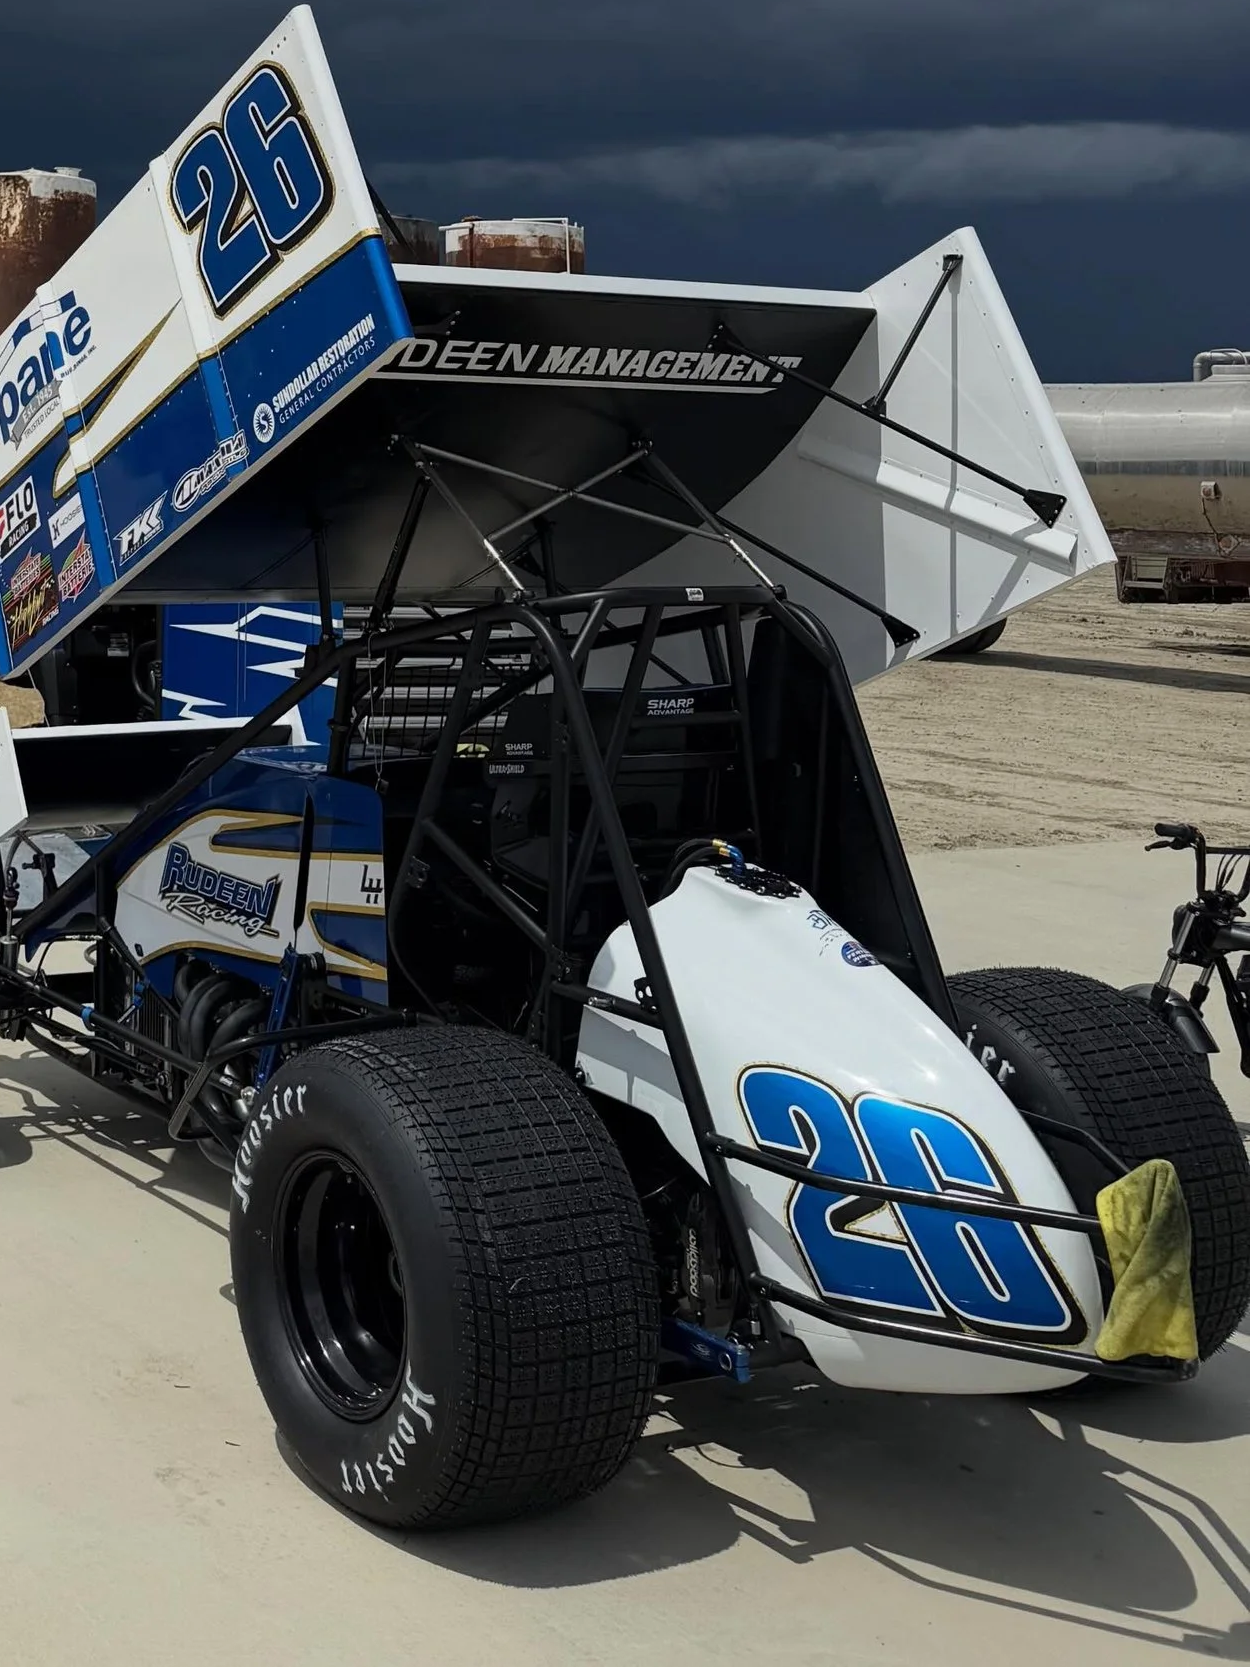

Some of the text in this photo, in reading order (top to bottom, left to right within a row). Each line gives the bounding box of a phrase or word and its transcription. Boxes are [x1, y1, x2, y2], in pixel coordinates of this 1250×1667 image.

[171, 63, 330, 313] 26
[272, 313, 376, 414] SUNDOLLAR RESTORATION
[278, 335, 376, 425] GENERAL CONTRACTORS
[398, 338, 803, 383] DEEN MANAGEMENT
[5, 481, 34, 531] FLO
[8, 521, 30, 548] RACING
[62, 562, 93, 597] BATTERIE
[646, 707, 695, 716] ADVANTAGE
[647, 697, 695, 709] SHARP
[504, 742, 533, 751] SHARP
[160, 841, 276, 918] RUDEEN
[164, 892, 280, 938] Racing
[230, 1083, 308, 1214] Hoosier
[737, 1063, 1082, 1338] 26
[340, 1360, 437, 1502] Hoosier
